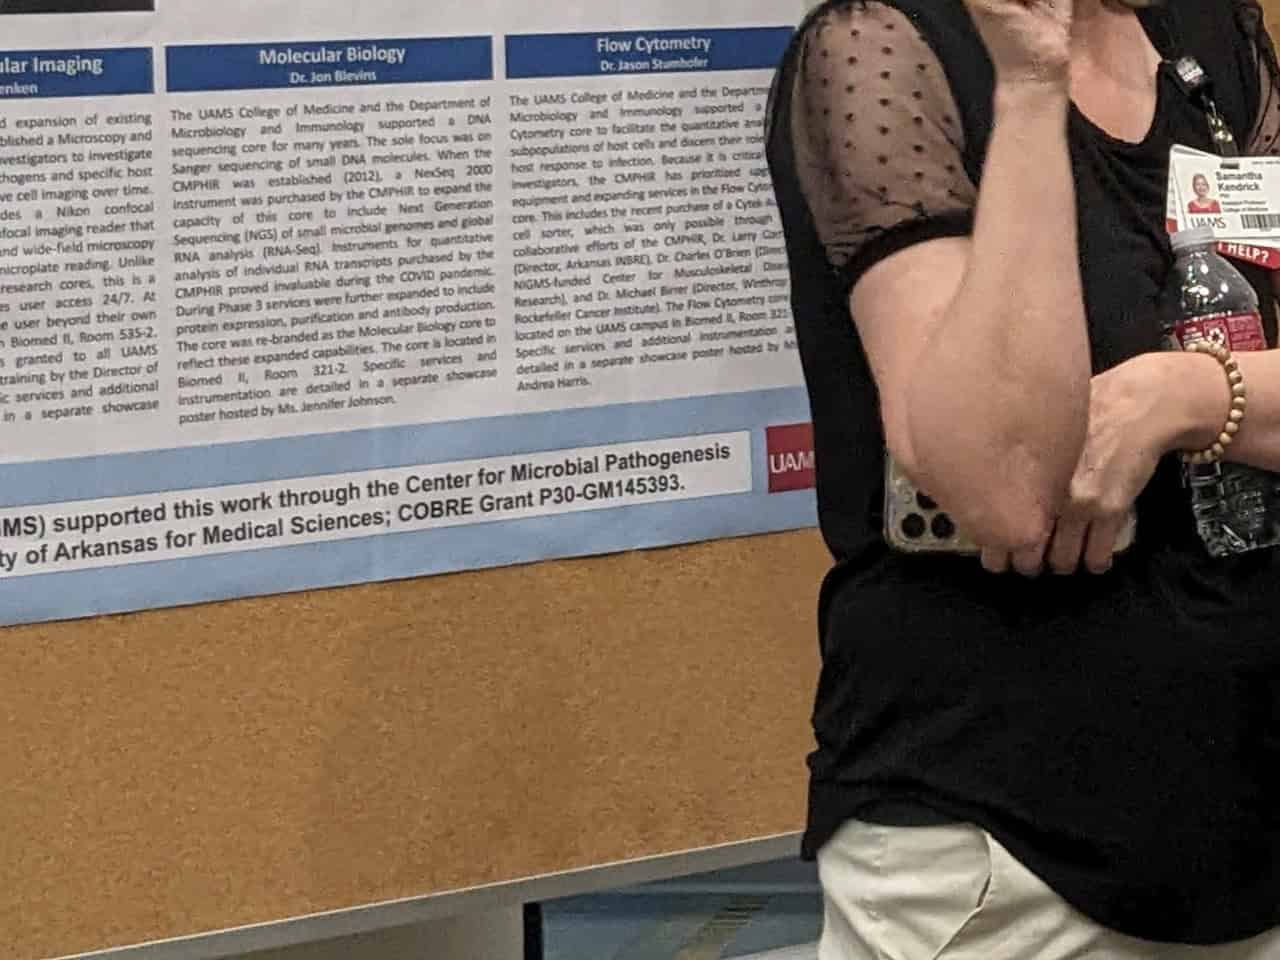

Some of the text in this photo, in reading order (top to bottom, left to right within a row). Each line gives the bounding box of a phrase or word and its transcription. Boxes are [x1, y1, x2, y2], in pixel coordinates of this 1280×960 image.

[260, 44, 407, 67] Molecular Biology
[596, 36, 711, 55] Flow Cytometry
[33, 55, 104, 80] Imaging
[600, 57, 708, 71] Dr. Jason Stumhofer
[289, 69, 377, 84] Dr. Jon Blevins
[171, 96, 491, 121] The UAMS College of Medicine and the Department of
[16, 115, 77, 131] expansion
[85, 113, 98, 126] of
[106, 111, 153, 128] existing
[1216, 171, 1263, 181] Samantha
[1217, 182, 1260, 192] Kendrick
[1227, 242, 1270, 263] HELP?
[517, 378, 555, 392] Andrea
[178, 410, 217, 427] poster
[219, 406, 258, 421] hosted
[261, 404, 275, 420] by
[277, 401, 298, 415] Ms.
[302, 396, 344, 414] Jennifer
[0, 442, 731, 540] MS) supported this work through the Center for Microbial Pathogenesis
[0, 474, 686, 573] ty of Arkansas for Medical Sciences; COBRE Grant P30-GM145393.
